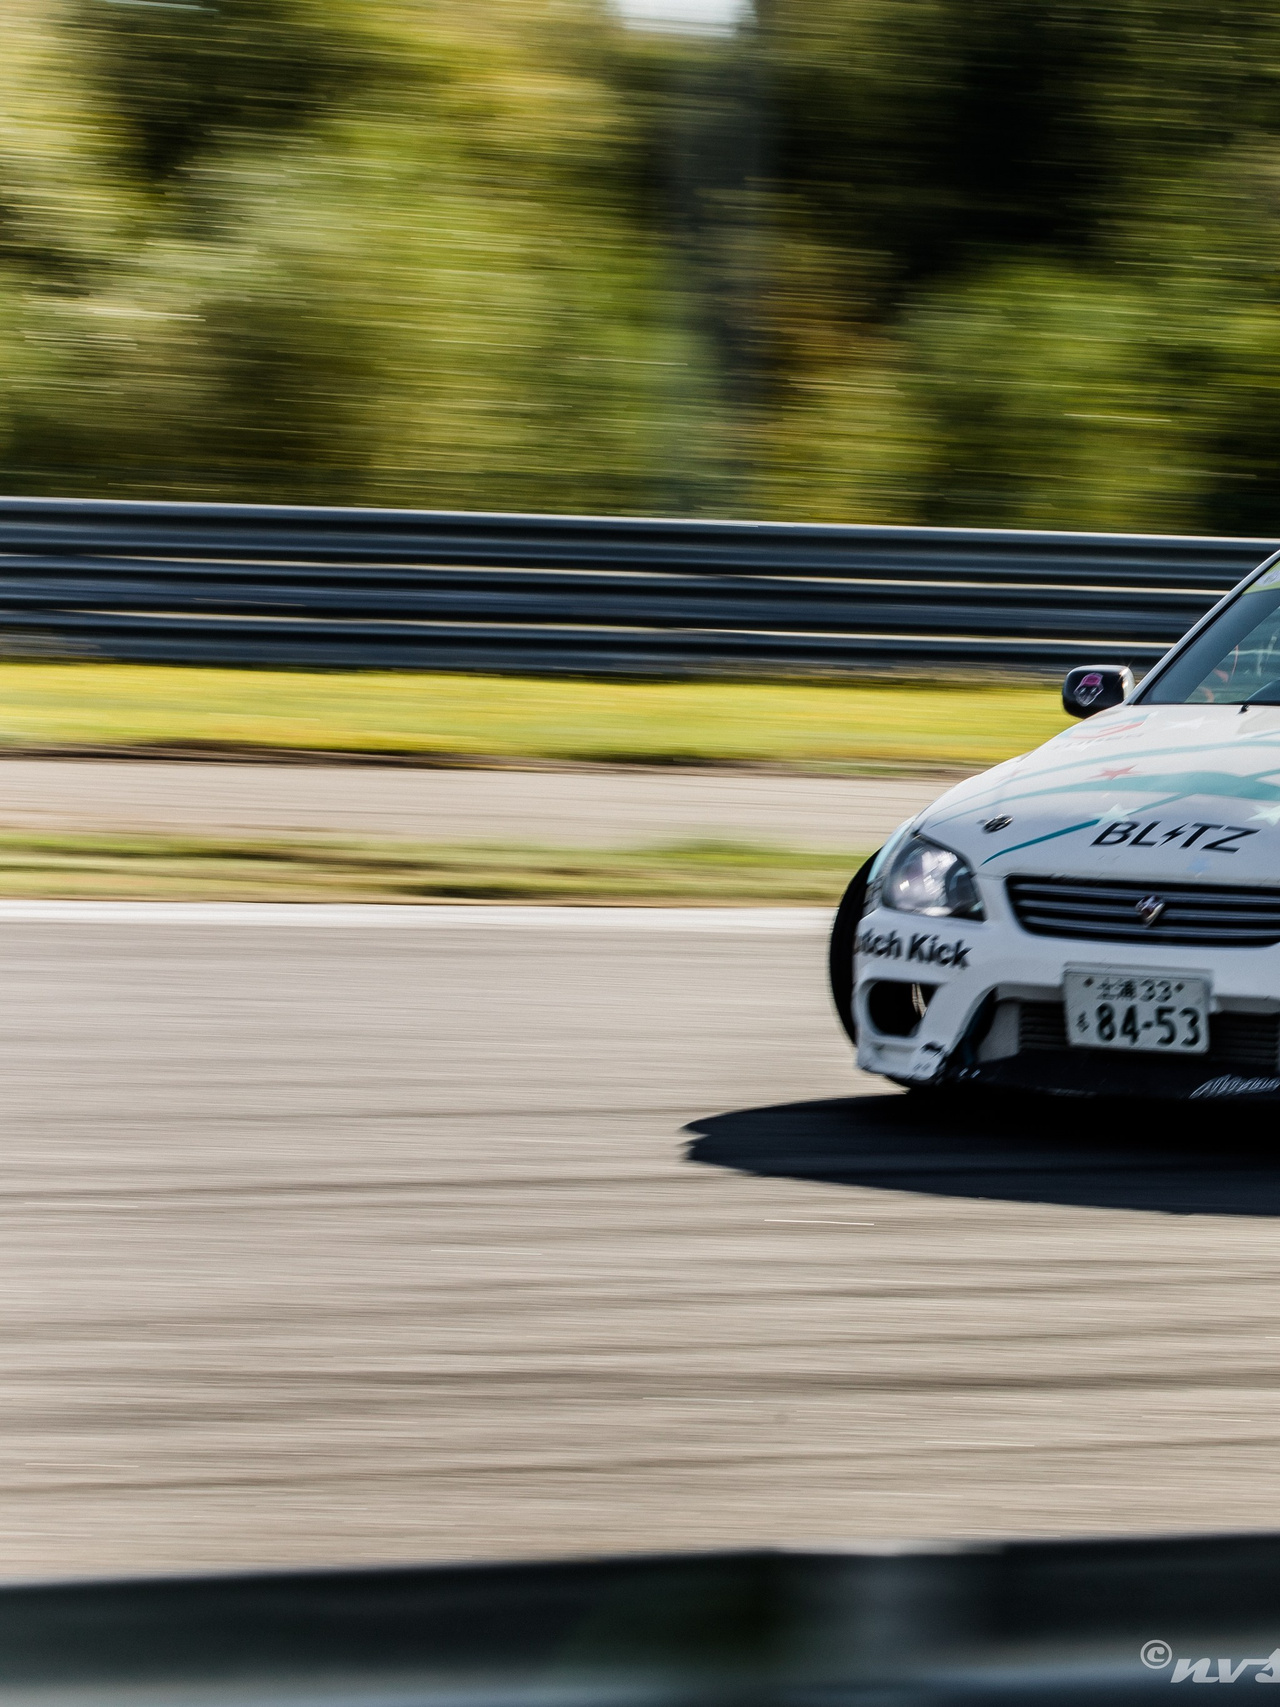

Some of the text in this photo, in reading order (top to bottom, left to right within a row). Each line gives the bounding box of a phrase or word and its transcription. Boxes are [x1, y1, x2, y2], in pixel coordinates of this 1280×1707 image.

[1089, 820, 1262, 854] BLITZ
[905, 932, 973, 970] Kick
[1140, 979, 1173, 1002] 33
[1096, 1003, 1200, 1047] 84-53
